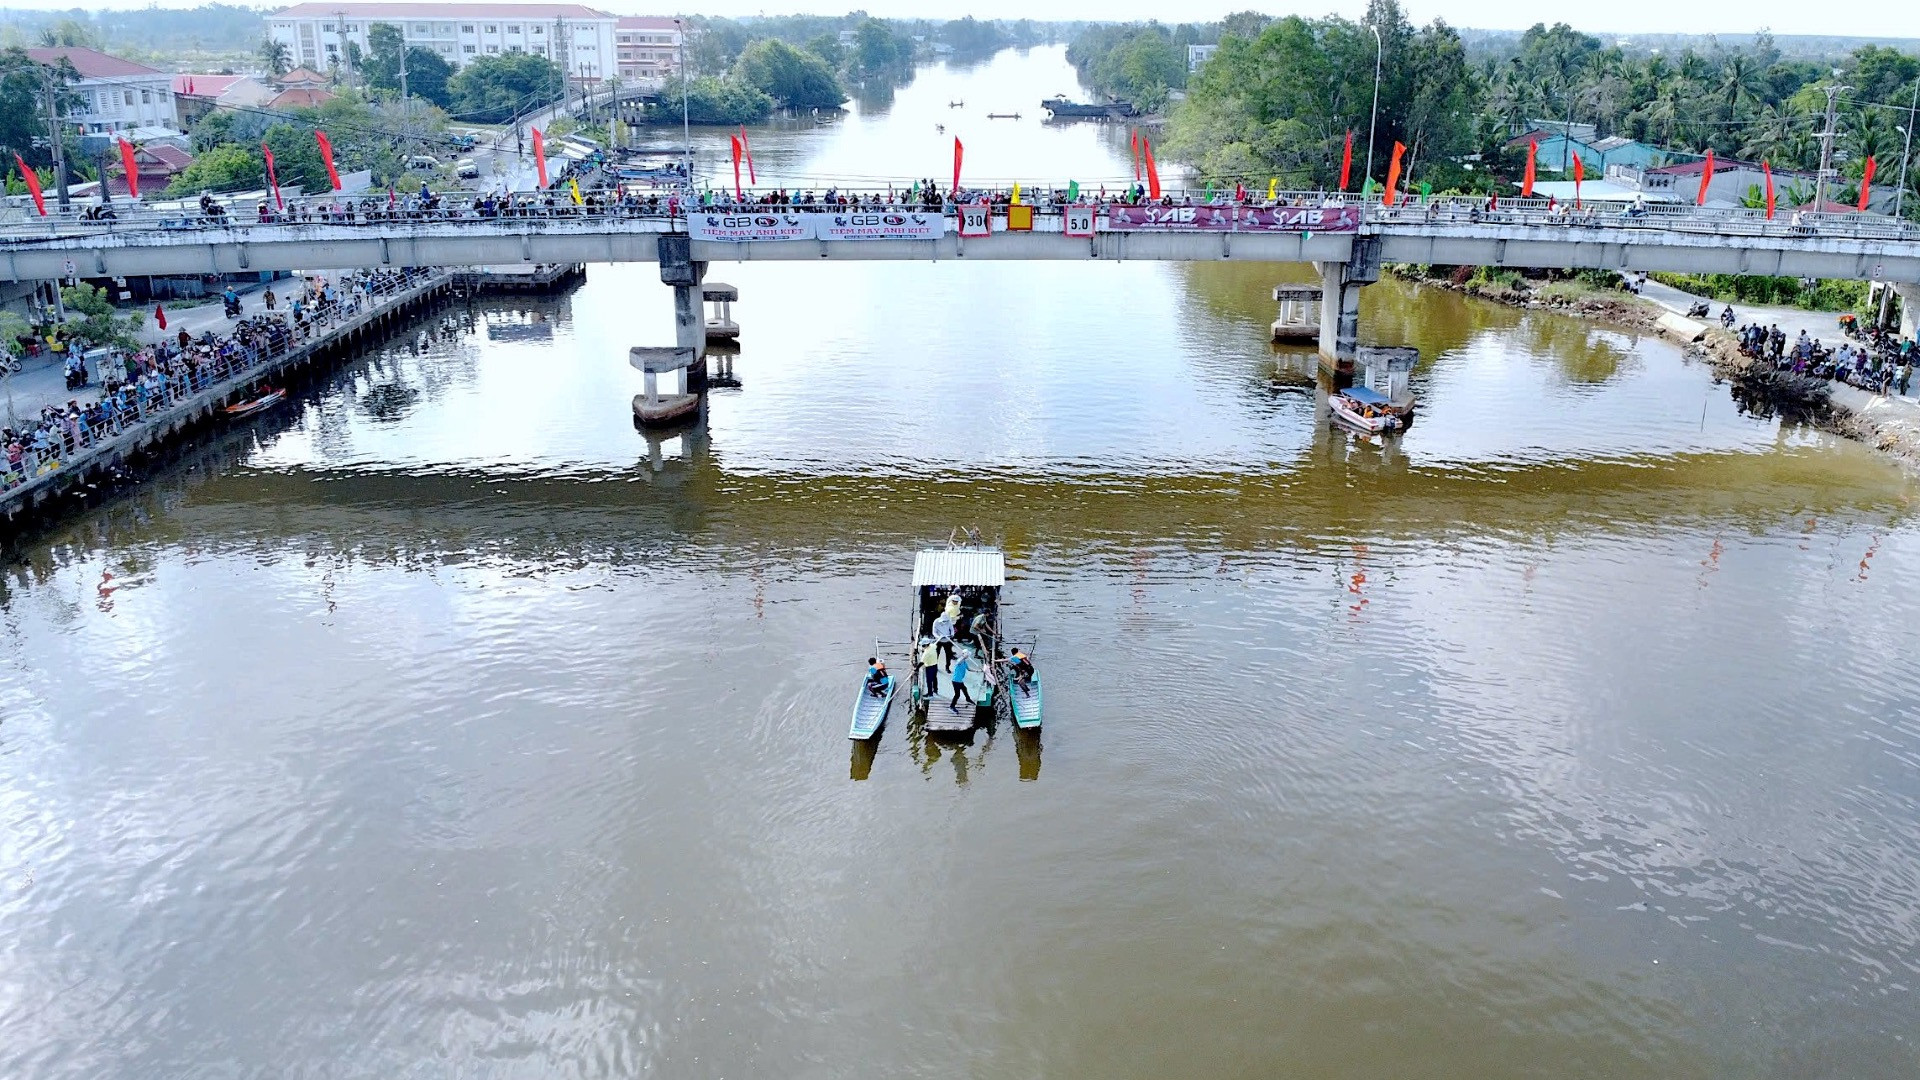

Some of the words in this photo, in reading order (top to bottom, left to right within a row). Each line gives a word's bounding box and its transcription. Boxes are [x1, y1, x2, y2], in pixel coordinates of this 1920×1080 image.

[851, 215, 880, 226] GB
[1159, 208, 1197, 222] AB
[1286, 210, 1324, 224] AB
[723, 216, 752, 228] GB
[1070, 218, 1089, 230] 5.0
